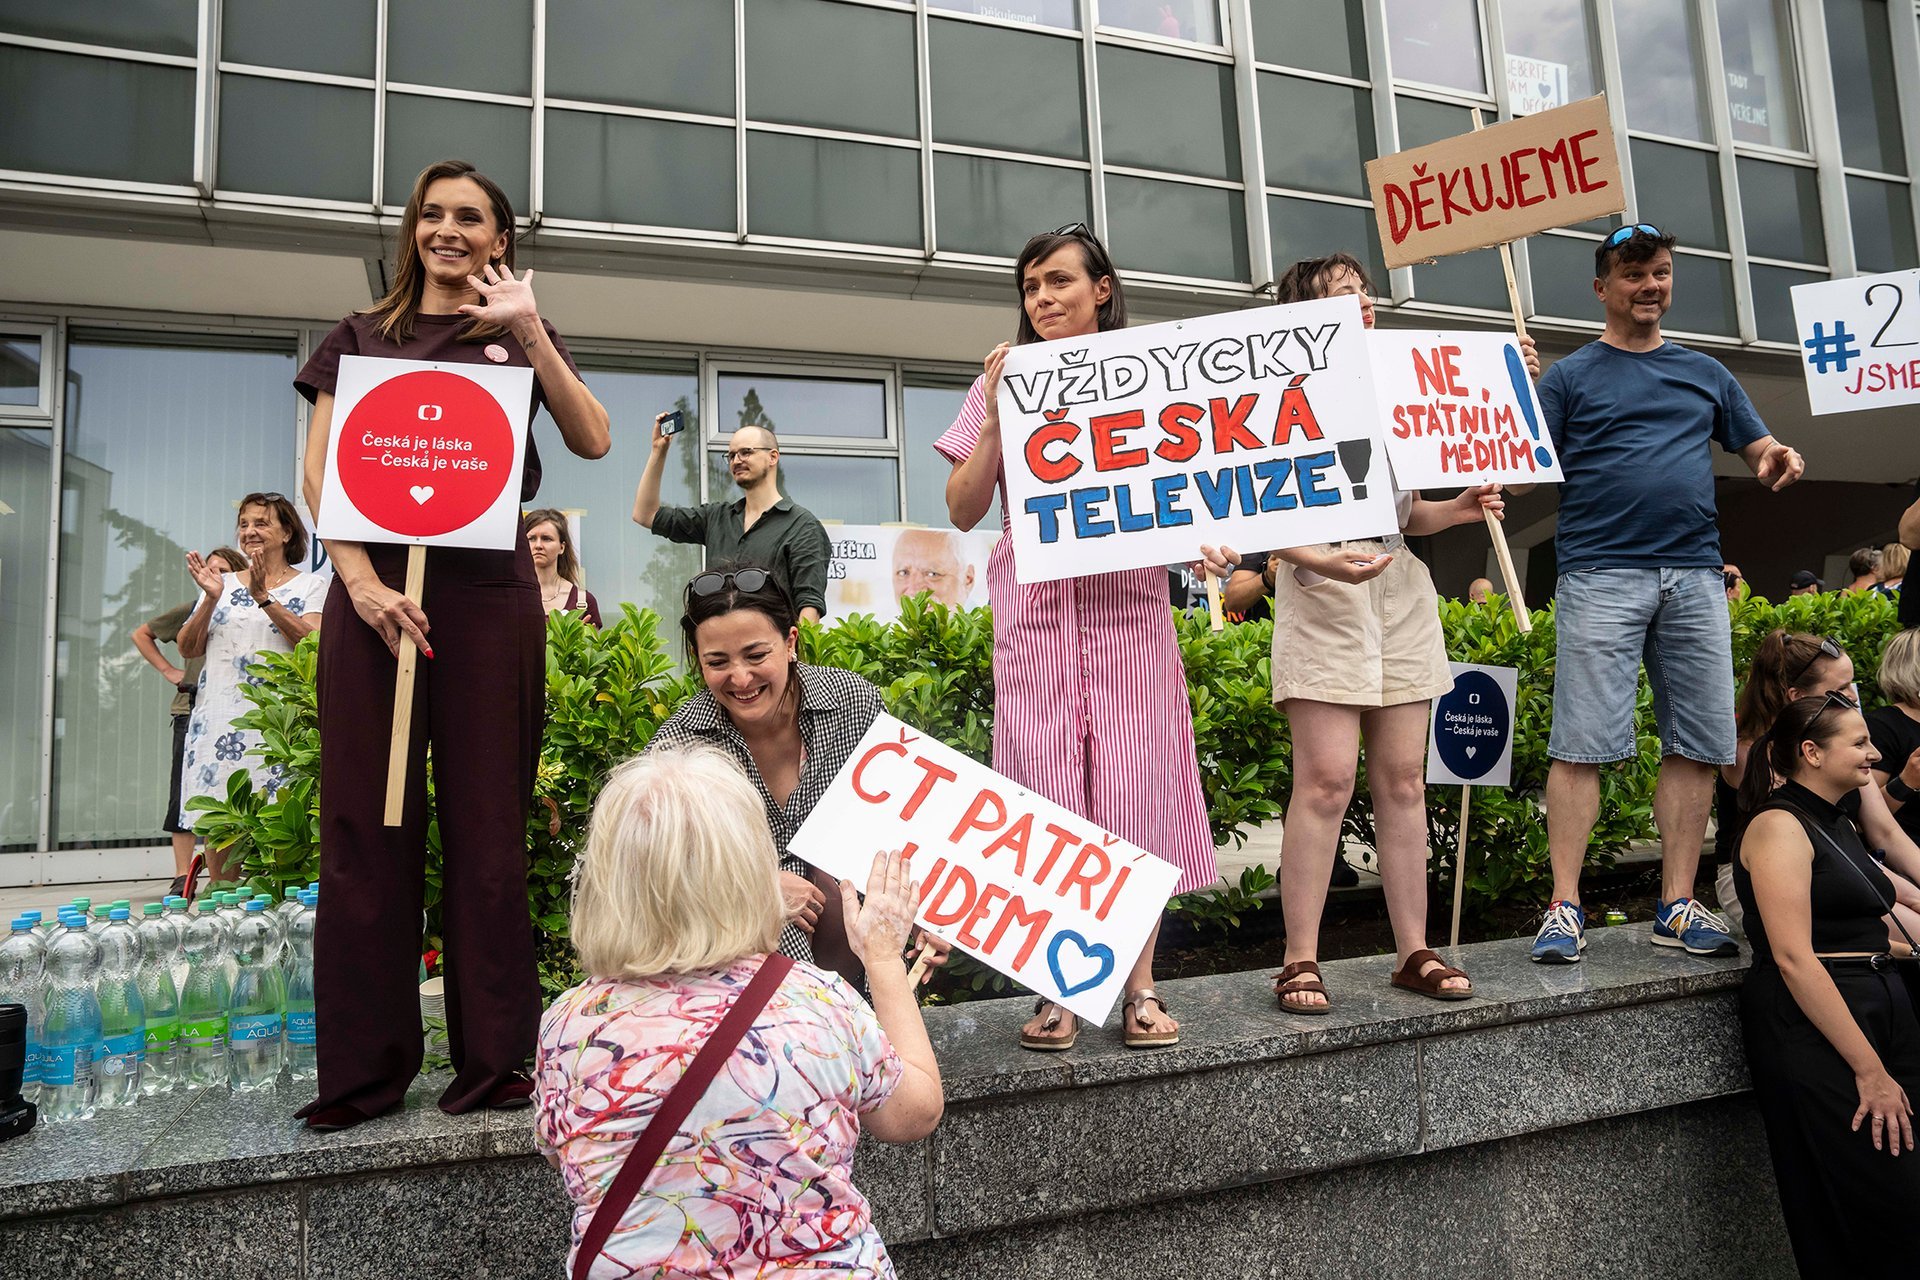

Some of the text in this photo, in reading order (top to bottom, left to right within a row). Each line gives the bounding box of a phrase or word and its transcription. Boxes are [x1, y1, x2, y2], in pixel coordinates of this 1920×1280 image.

[1383, 129, 1609, 245] DĚKUJEME
[1003, 323, 1341, 415] VŽDYCKY
[1024, 374, 1325, 484] ČESKÁ
[1392, 388, 1519, 439] STÁTNÍM
[361, 430, 473, 451] Česká je láska
[381, 450, 429, 468] Česká
[432, 456, 447, 472] je
[451, 457, 488, 471] vaše
[1024, 437, 1373, 543] TELEVIZE!
[827, 560, 846, 579] ÁS
[830, 540, 876, 560] TÉČKA
[1444, 710, 1493, 725] Česká je láska
[1453, 723, 1475, 735] Česká
[1475, 726, 1482, 737] je
[1483, 727, 1499, 737] vaše
[852, 727, 1147, 922] ČT PATŘÍ
[900, 841, 1053, 973] IDEM
